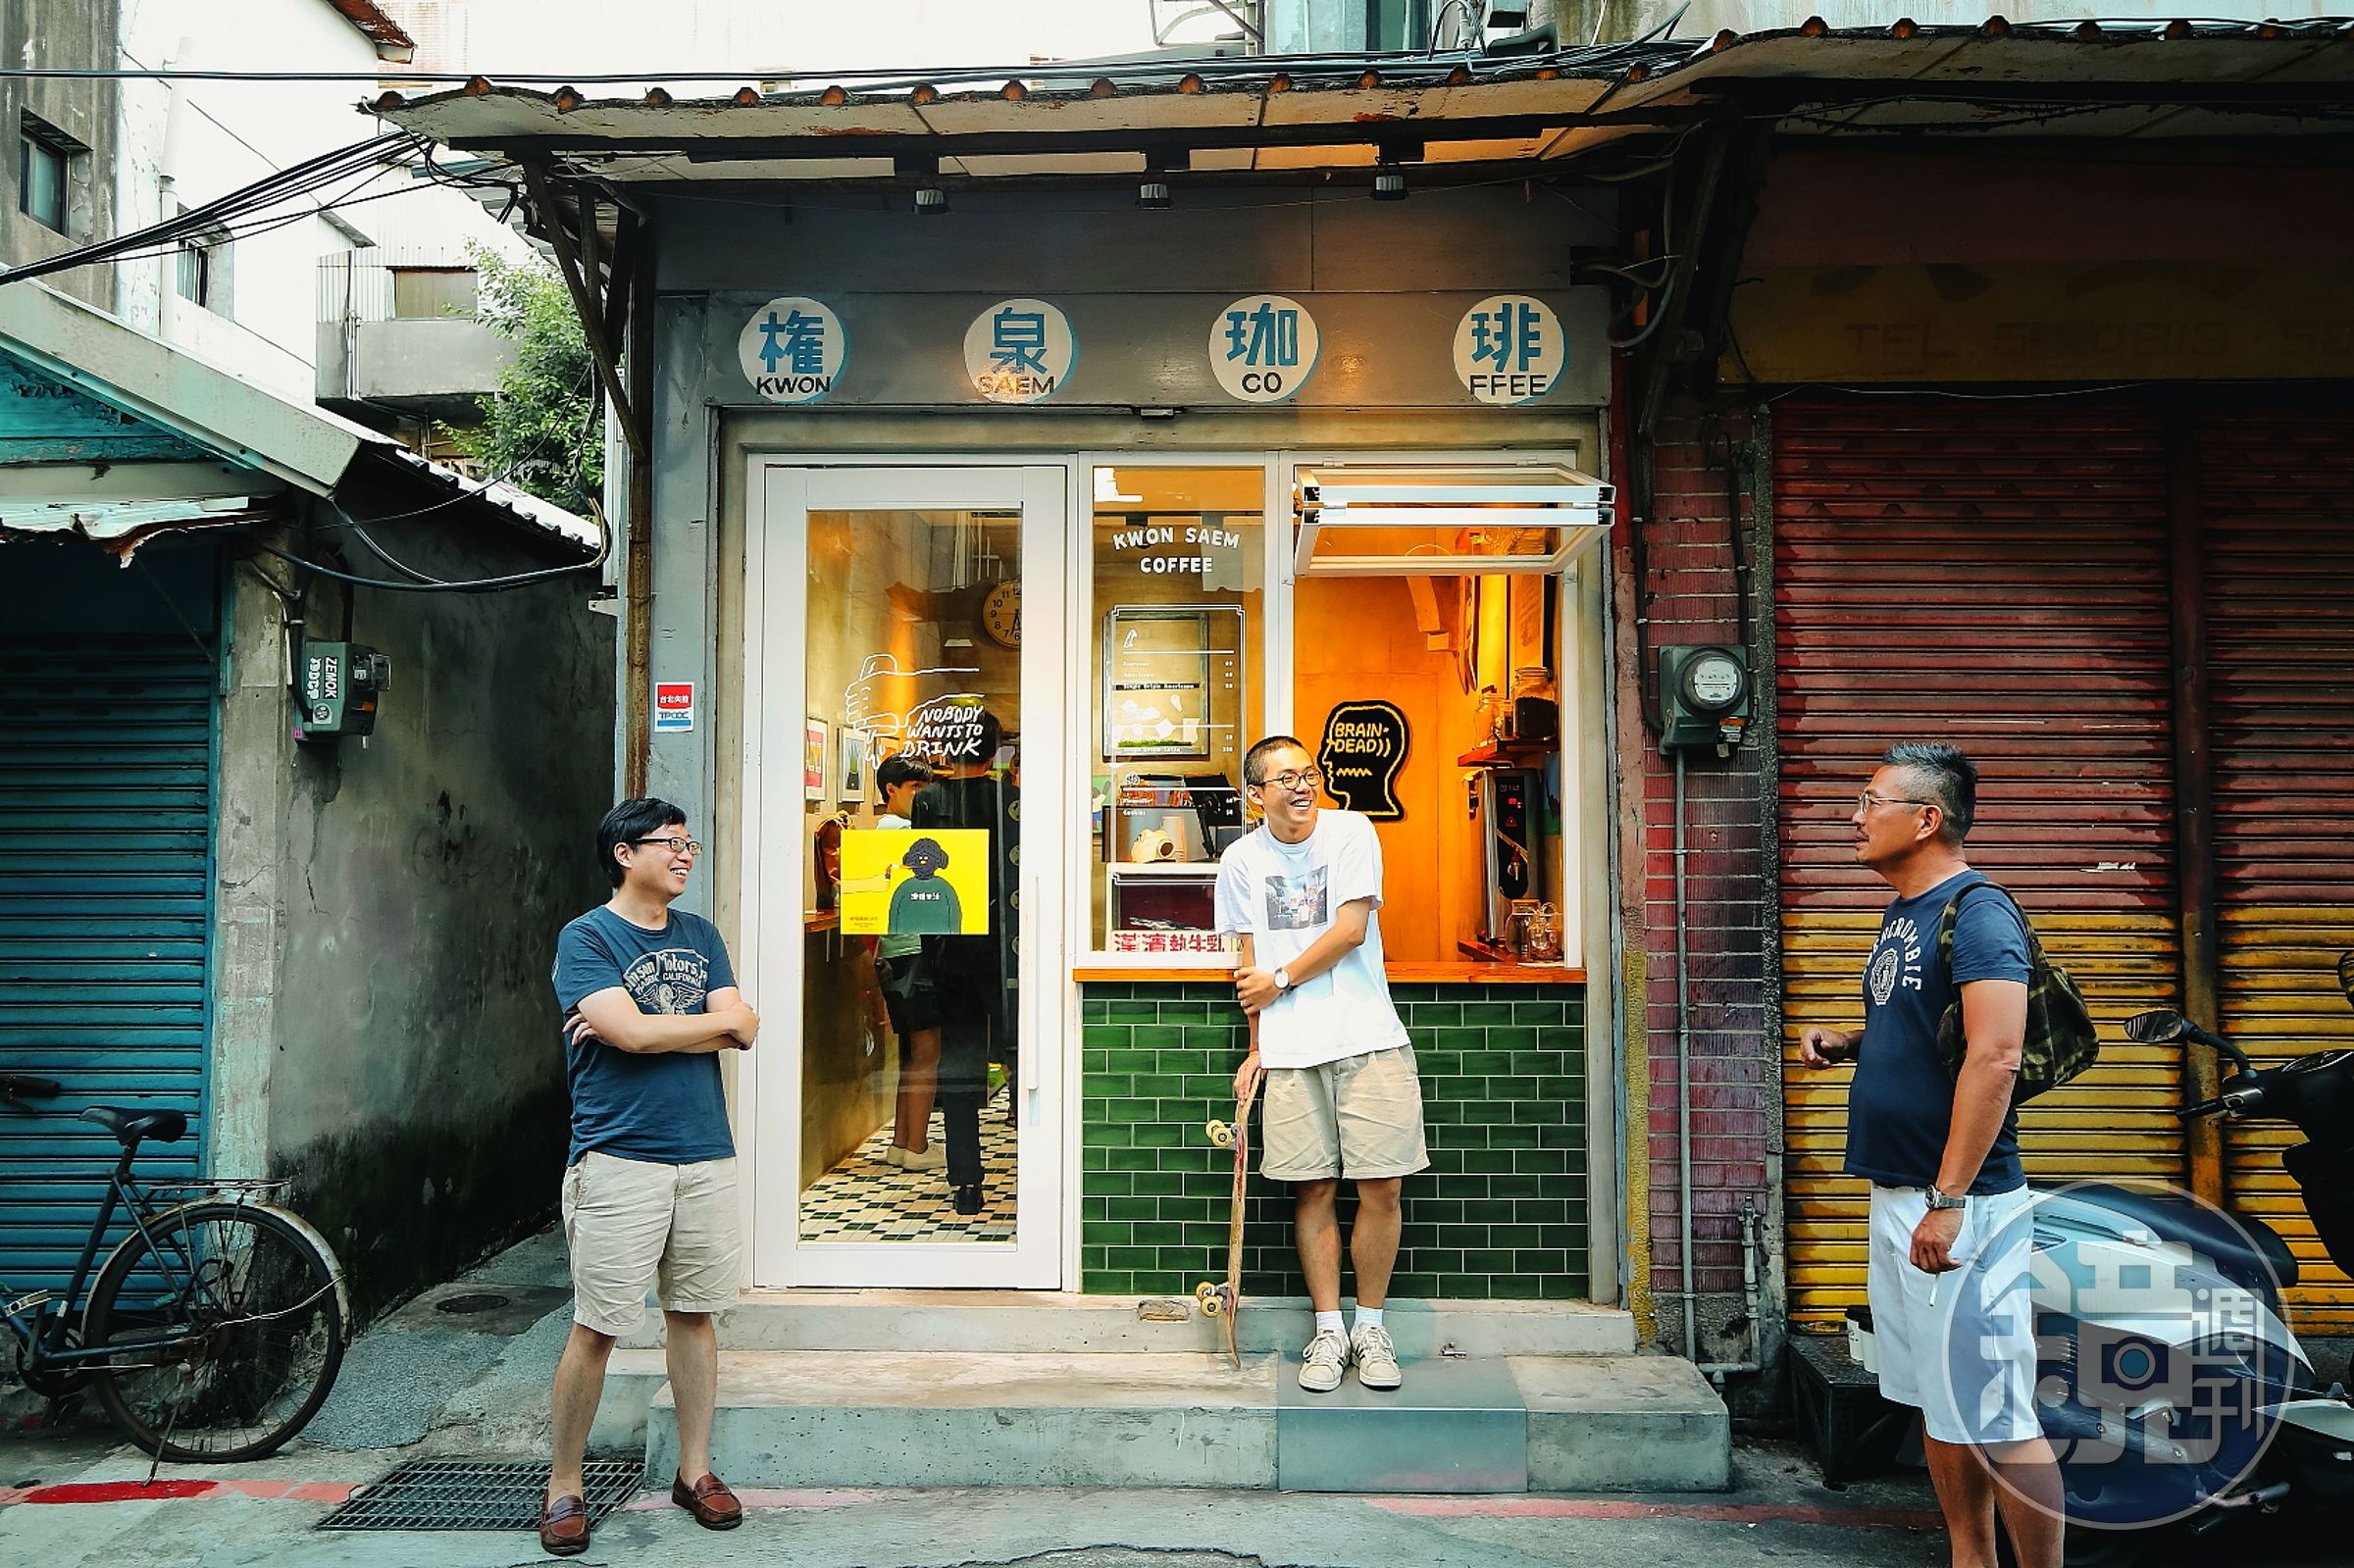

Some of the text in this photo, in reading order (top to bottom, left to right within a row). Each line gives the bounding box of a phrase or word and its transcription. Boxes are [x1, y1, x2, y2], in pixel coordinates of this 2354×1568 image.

[989, 307, 1049, 375] 泉
[1225, 303, 1299, 367] 珈
[1470, 302, 1542, 373] 琲
[756, 372, 1548, 397] KWON SAEM CO FFEE
[1112, 527, 1240, 550] KWON SAEM
[1139, 557, 1213, 574] COFFEE
[993, 599, 1003, 608] 10
[1003, 629, 1009, 637] 7
[915, 705, 984, 727] NOBODY
[907, 723, 984, 738] WANTS TO
[898, 737, 982, 758] DRINK
